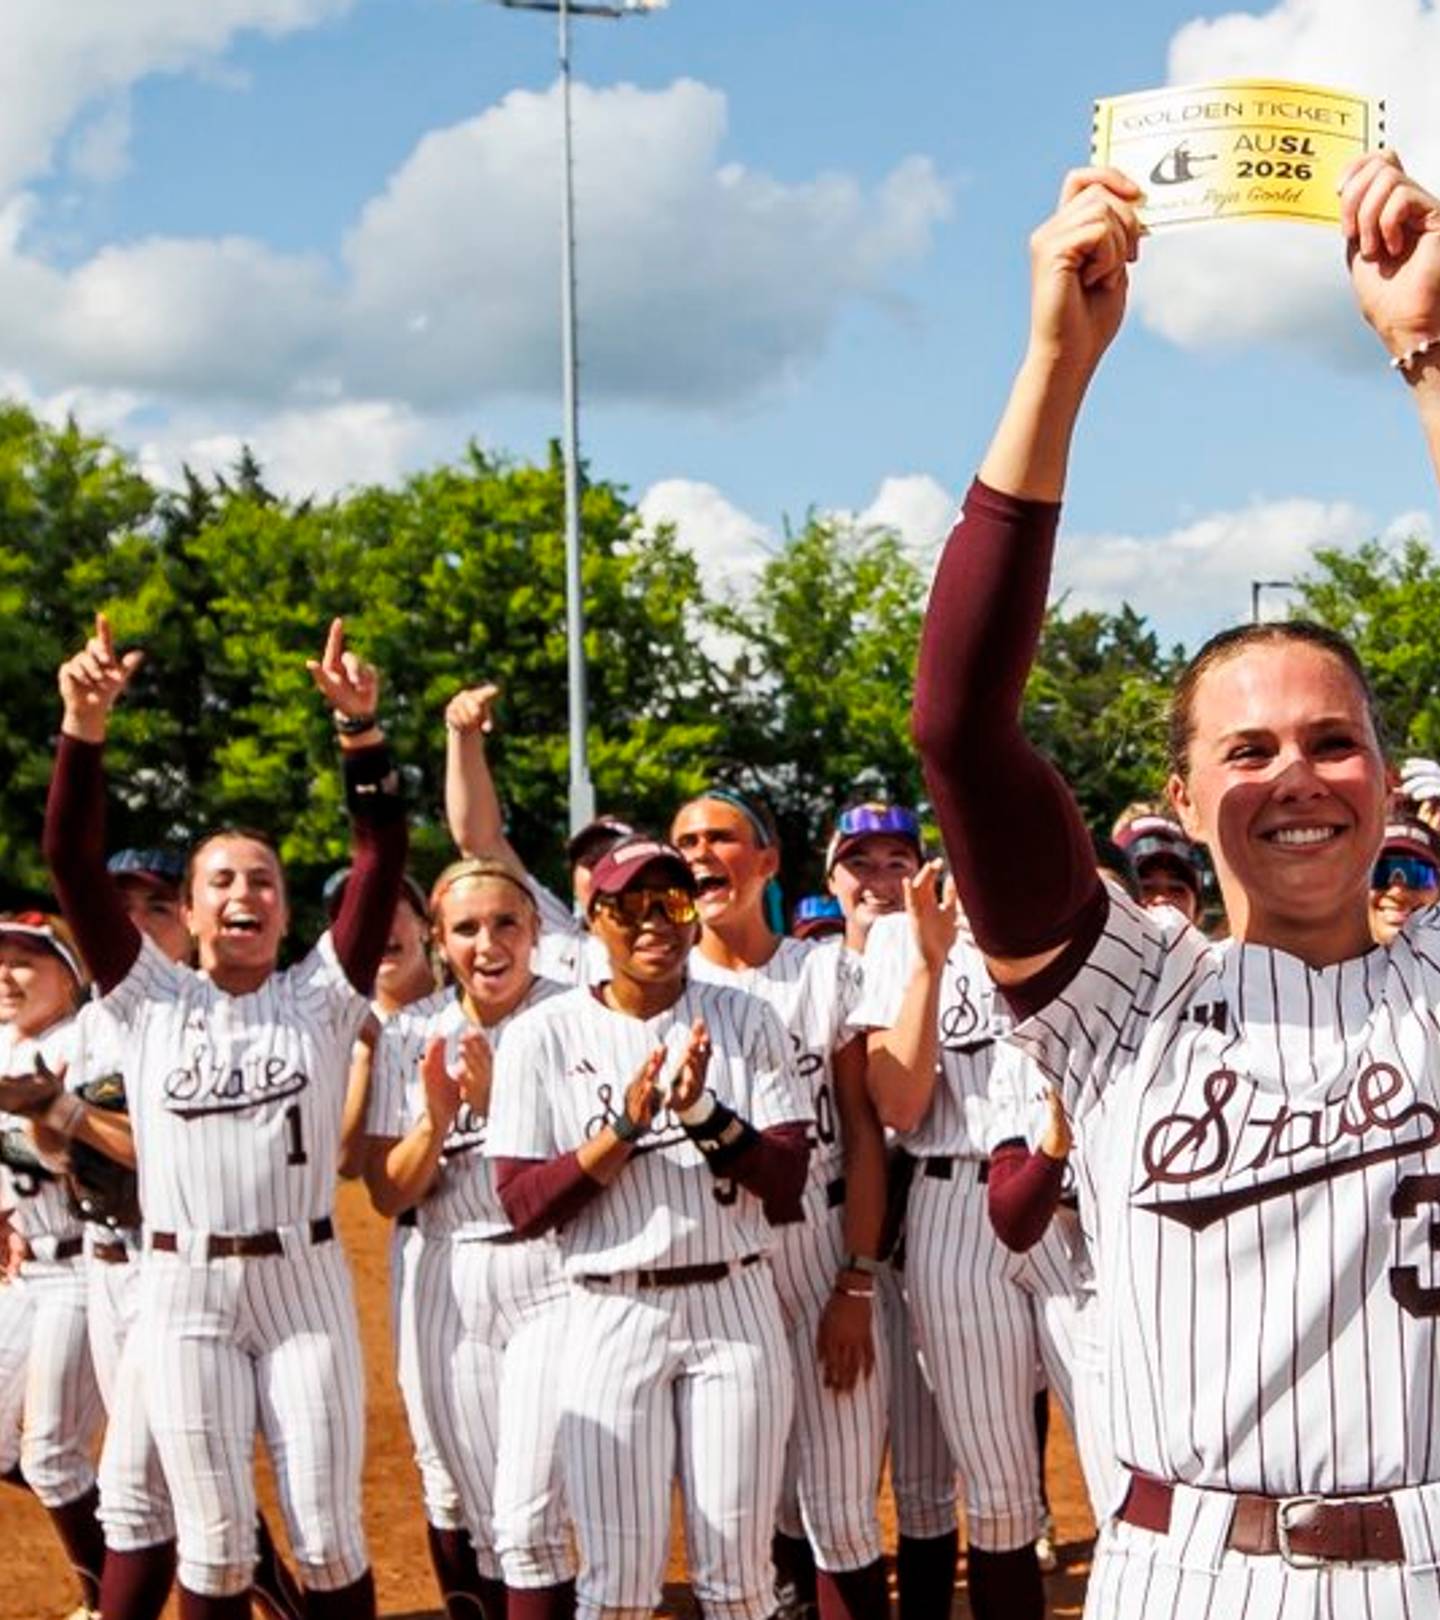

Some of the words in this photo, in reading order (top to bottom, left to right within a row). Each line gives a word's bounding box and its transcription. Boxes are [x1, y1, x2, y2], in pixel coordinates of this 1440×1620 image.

[1122, 102, 1243, 130] GOLDEN
[1252, 102, 1350, 126] TICKET
[1232, 134, 1317, 156] AUSL
[1236, 161, 1312, 180] 2026
[285, 1104, 307, 1165] 1
